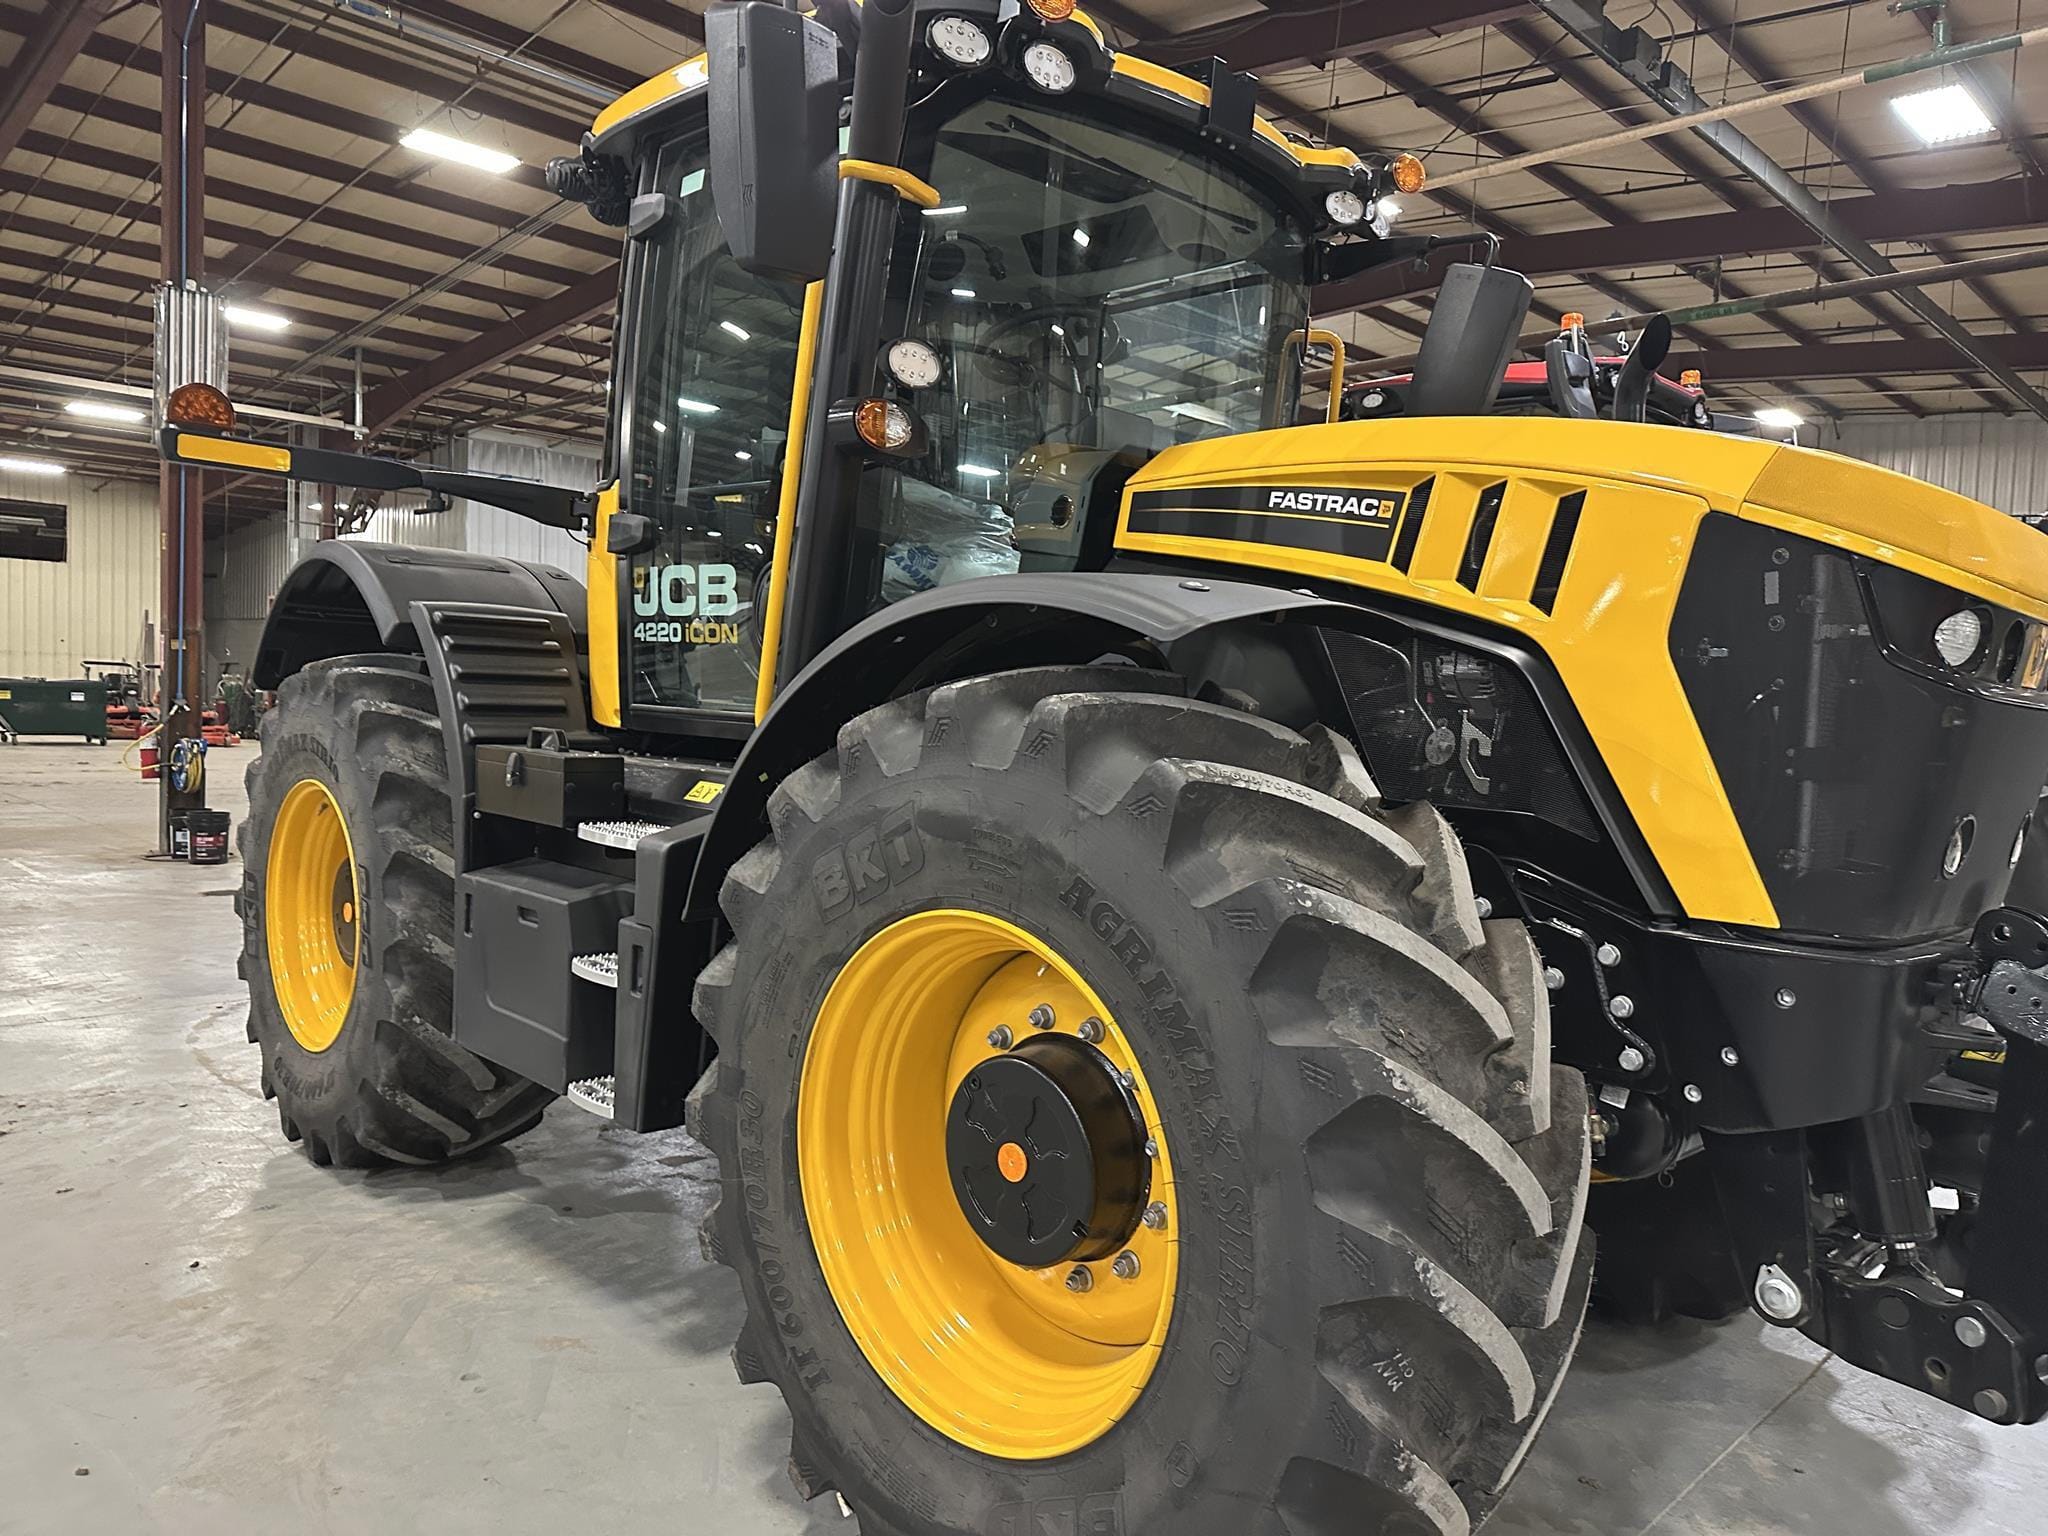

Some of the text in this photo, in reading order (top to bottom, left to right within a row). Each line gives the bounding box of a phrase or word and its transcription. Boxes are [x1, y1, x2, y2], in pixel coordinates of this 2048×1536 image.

[1268, 491, 1380, 517] FASTRAC
[634, 564, 738, 617] JCB
[634, 622, 738, 644] 4220 iCON
[813, 806, 924, 922] BKT
[1058, 872, 1256, 1389] AGRIMAX SIRIO
[738, 1089, 804, 1343] 600/70R30
